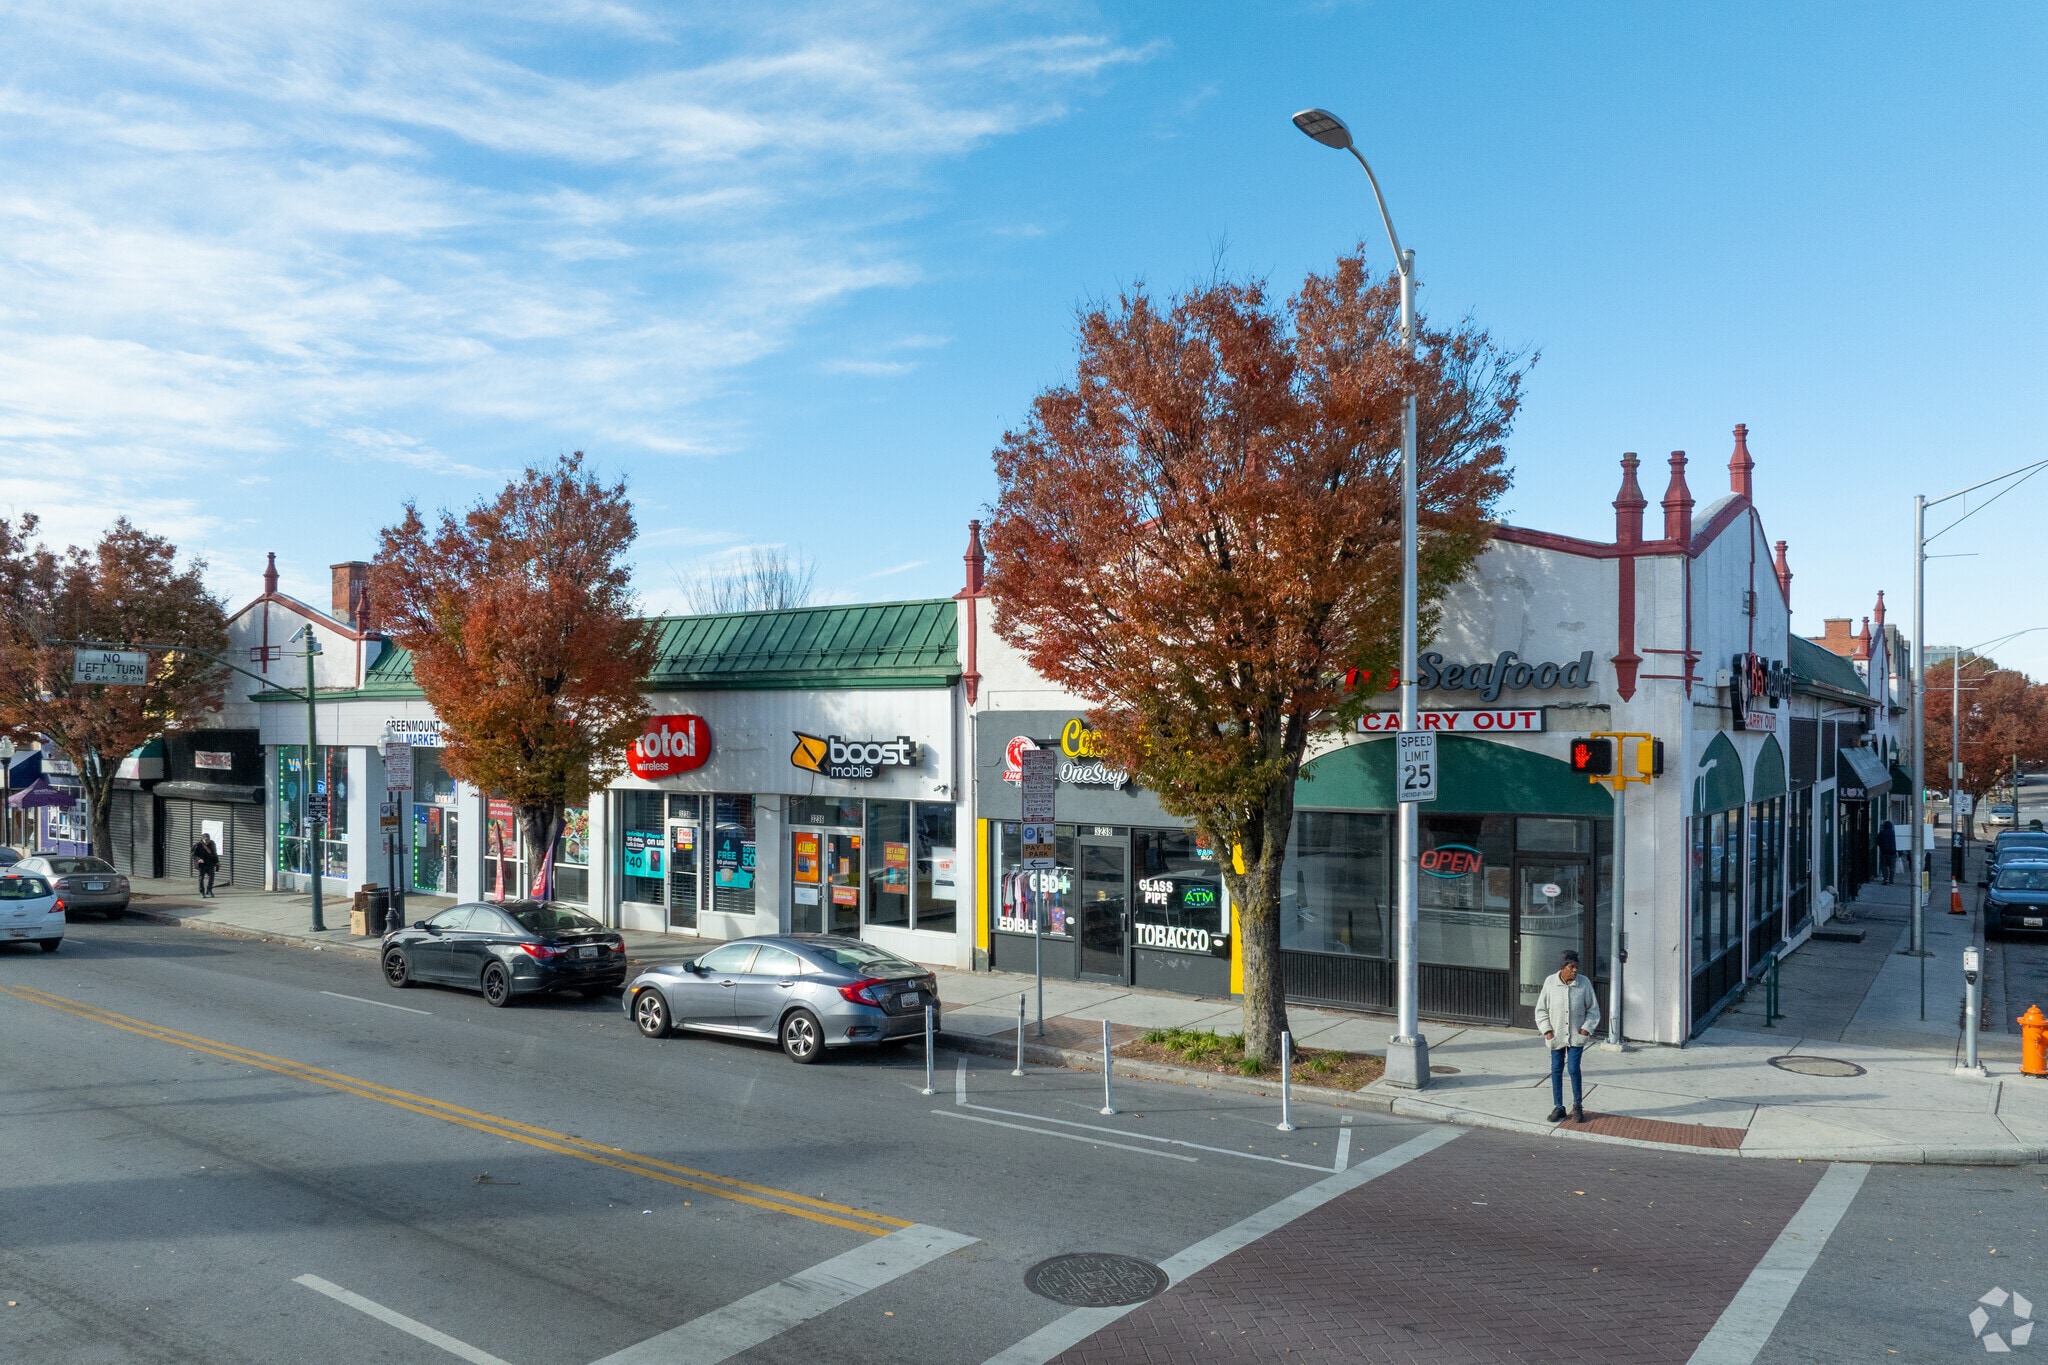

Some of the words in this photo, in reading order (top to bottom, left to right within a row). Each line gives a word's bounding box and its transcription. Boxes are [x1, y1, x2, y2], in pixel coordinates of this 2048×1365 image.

[103, 653, 120, 663] NO
[78, 663, 106, 673] LEFT
[116, 664, 143, 675] TURN
[84, 673, 91, 681] 6
[122, 675, 128, 683] 9
[1417, 651, 1593, 702] Seafood
[1363, 713, 1460, 731] CARY
[1473, 712, 1536, 729] OUT
[406, 733, 439, 746] MARKET
[635, 720, 696, 758] total
[1401, 736, 1432, 747] SPEED
[829, 738, 910, 765] boost
[1405, 750, 1429, 762] LIMIT
[636, 761, 669, 771] wireless
[831, 765, 873, 778] mobile
[1404, 764, 1431, 789] 25
[1095, 827, 1112, 836] 3238
[723, 840, 730, 850] 4
[717, 851, 737, 860] FREE
[1420, 850, 1483, 873] OPEN
[626, 856, 642, 868] $40
[1139, 879, 1173, 893] GLASS
[1144, 892, 1168, 905] PIPE
[1184, 892, 1214, 902] ATM
[1135, 923, 1209, 951] TOBACCO
